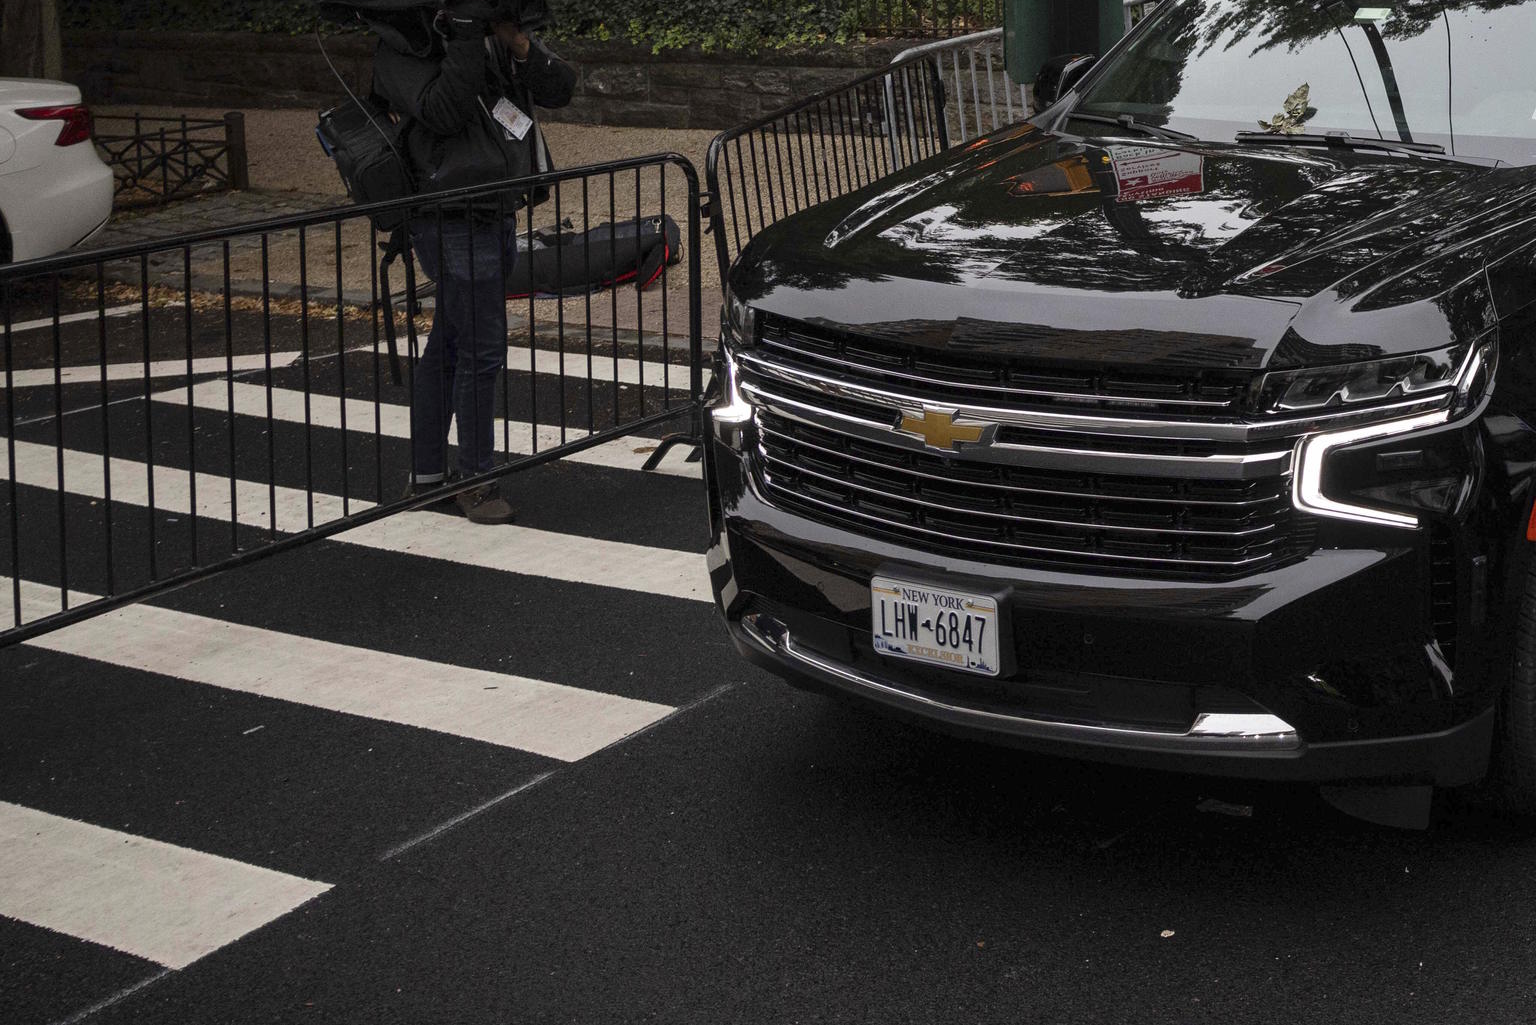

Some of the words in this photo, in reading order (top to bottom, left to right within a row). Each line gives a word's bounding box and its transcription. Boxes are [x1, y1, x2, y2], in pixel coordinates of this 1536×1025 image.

[902, 588, 930, 604] NEW
[932, 593, 965, 611] YORK
[935, 610, 986, 654] 6847
